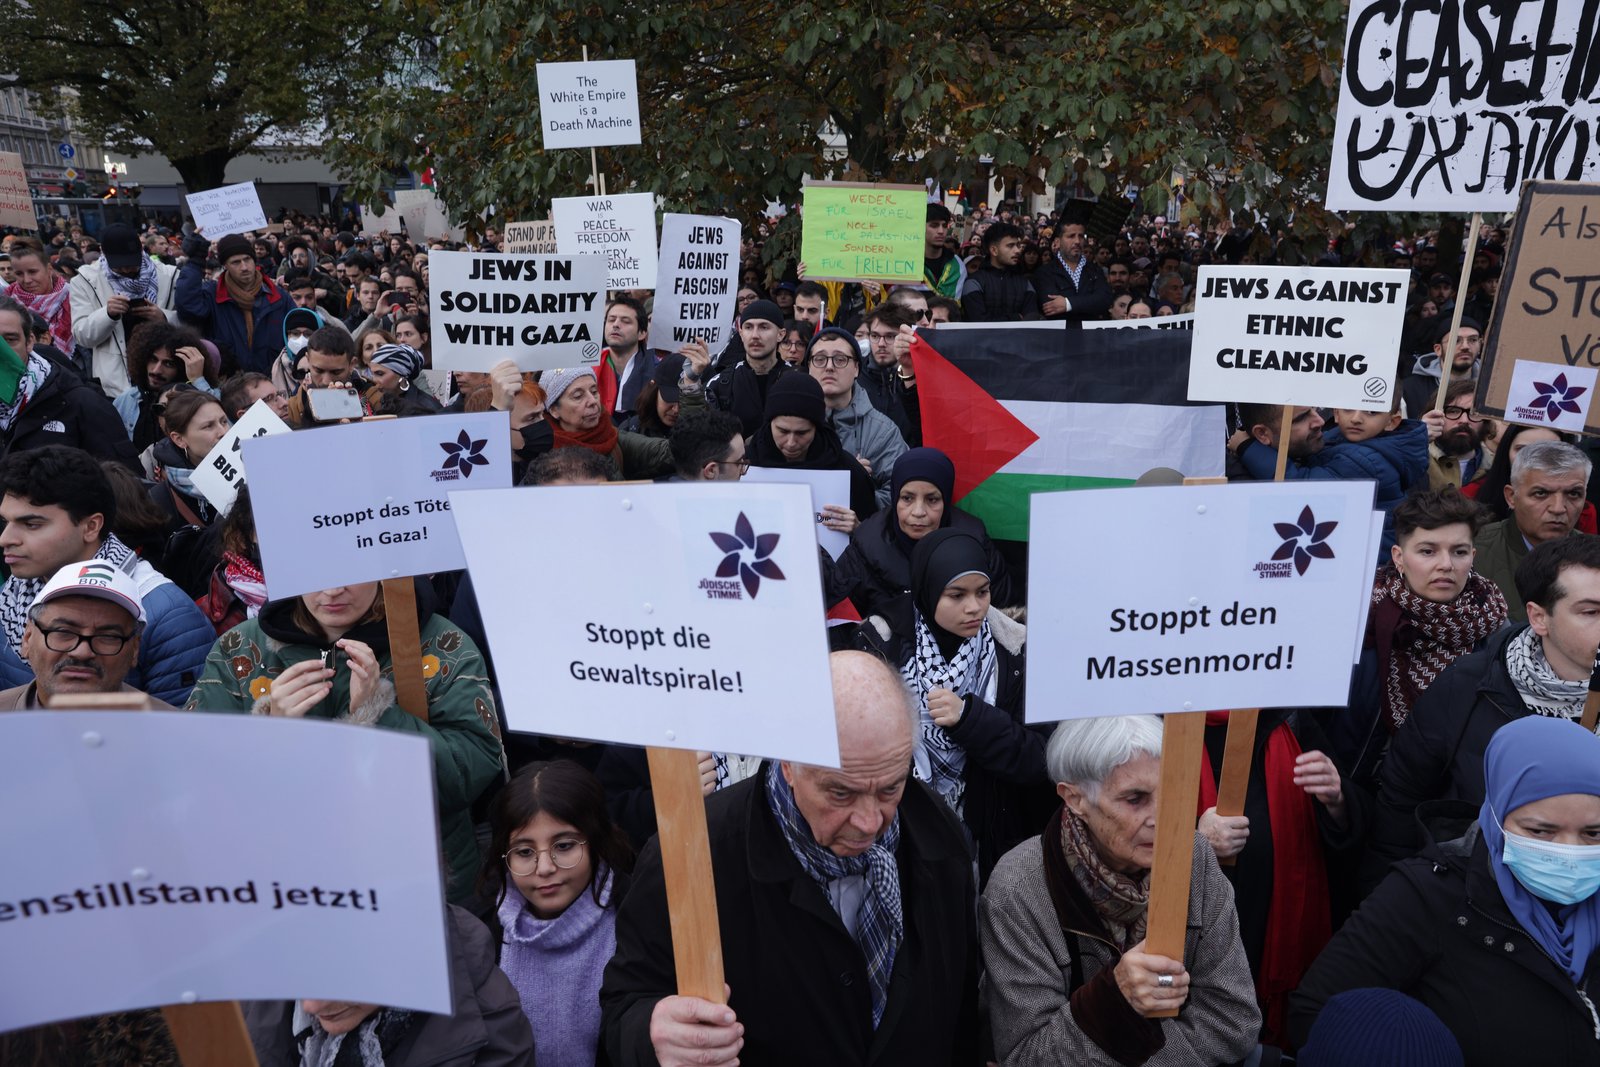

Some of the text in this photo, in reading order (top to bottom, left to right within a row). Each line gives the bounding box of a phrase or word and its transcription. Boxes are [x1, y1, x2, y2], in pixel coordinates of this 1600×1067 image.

[576, 76, 598, 87] The
[550, 89, 626, 103] White Empire
[579, 105, 598, 115] is a
[550, 117, 632, 131] Death Machine
[587, 200, 613, 211] WAR
[849, 194, 897, 205] WEDER
[826, 204, 913, 220] FÜR ISRAEL
[847, 222, 878, 230] NOCH
[508, 226, 534, 243] STAND
[537, 226, 546, 241] UP
[578, 232, 631, 243] FREEDOM
[689, 226, 723, 244] JEWS
[825, 229, 849, 240] FÜR
[840, 244, 893, 254] SONDERN
[608, 260, 639, 270] RANCE
[678, 252, 728, 270] AGAINST
[469, 259, 572, 281] JEWS IN
[607, 278, 639, 287] ENGTH
[673, 278, 728, 295] FASCISM
[1202, 277, 1402, 304] JEWS AGAINST
[440, 291, 598, 313] SOLIDARITY
[680, 303, 719, 320] EVERY
[444, 323, 591, 346] WITH GAZA
[1246, 314, 1345, 339] ETHNIC
[673, 327, 720, 343] WHERE!
[1216, 348, 1368, 375] CLEANSING
[1513, 406, 1545, 415] JÜDISCHE
[1518, 413, 1544, 421] STIMME
[213, 454, 238, 482] BIS
[430, 469, 459, 477] JÜDISCHE
[312, 499, 451, 529] Stoppt das Töte
[356, 526, 428, 549] in Gaza!
[1253, 562, 1292, 571] JÜDISCHE
[1259, 570, 1292, 578] STIMME
[79, 578, 107, 587] BDS
[698, 578, 741, 590] JÜDISCHE
[707, 589, 742, 600] STIMME
[1109, 601, 1277, 635] Stoppt den
[586, 622, 711, 651] Stoppt die
[1087, 645, 1294, 680] Massenmord!
[569, 660, 743, 693] Gewaltspirale!
[0, 881, 379, 922] enstillstand jetzt!
